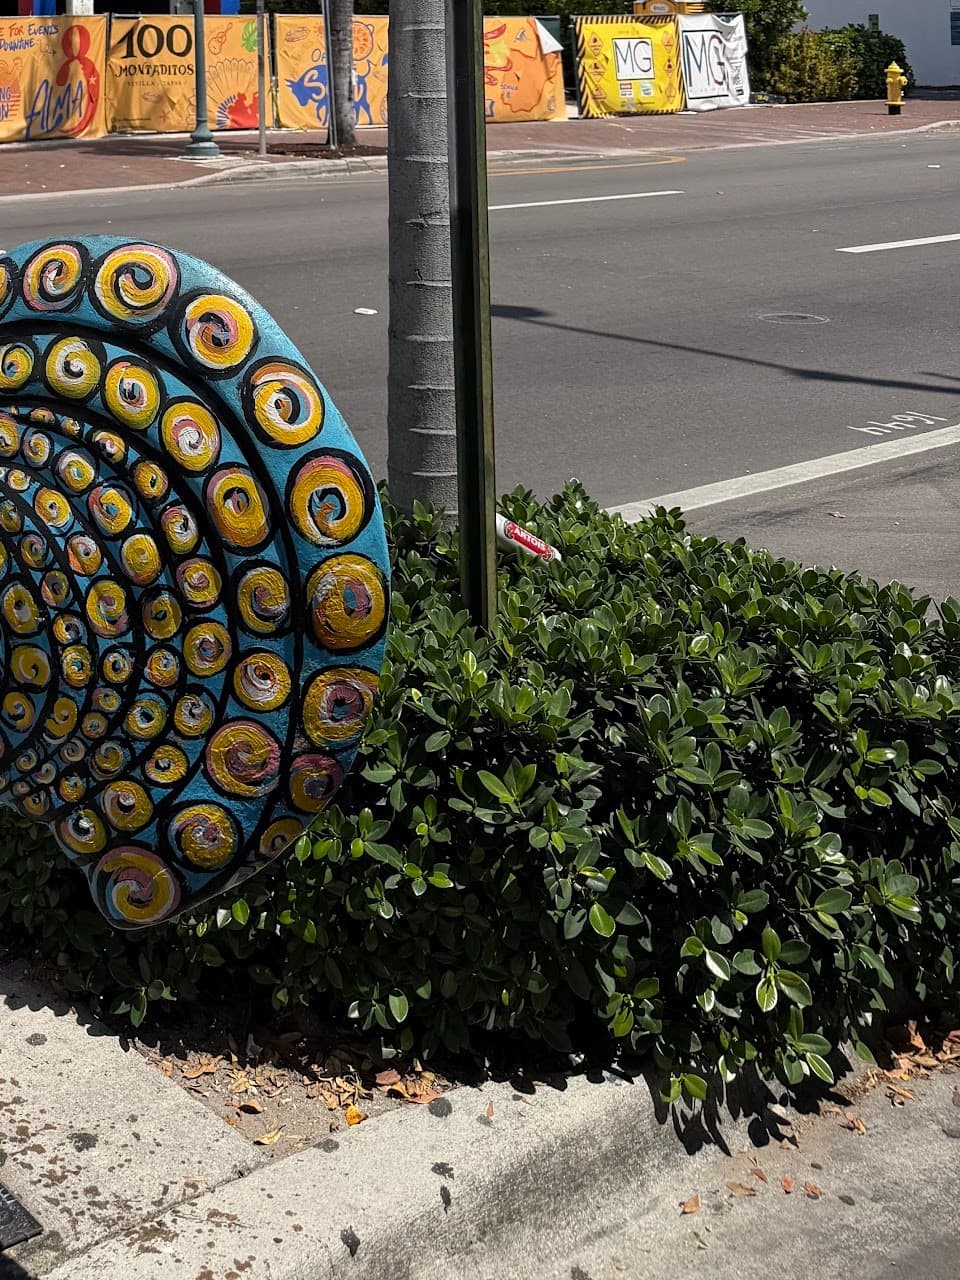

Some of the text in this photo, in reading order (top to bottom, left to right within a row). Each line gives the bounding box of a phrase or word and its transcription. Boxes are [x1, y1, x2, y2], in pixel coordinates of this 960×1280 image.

[8, 22, 24, 37] FOR
[27, 23, 59, 36] EVENTS
[110, 24, 193, 59] 100
[114, 63, 194, 78] MONTADITOS
[614, 40, 652, 73] MG
[685, 33, 726, 87] MG
[24, 79, 83, 140] ALMA
